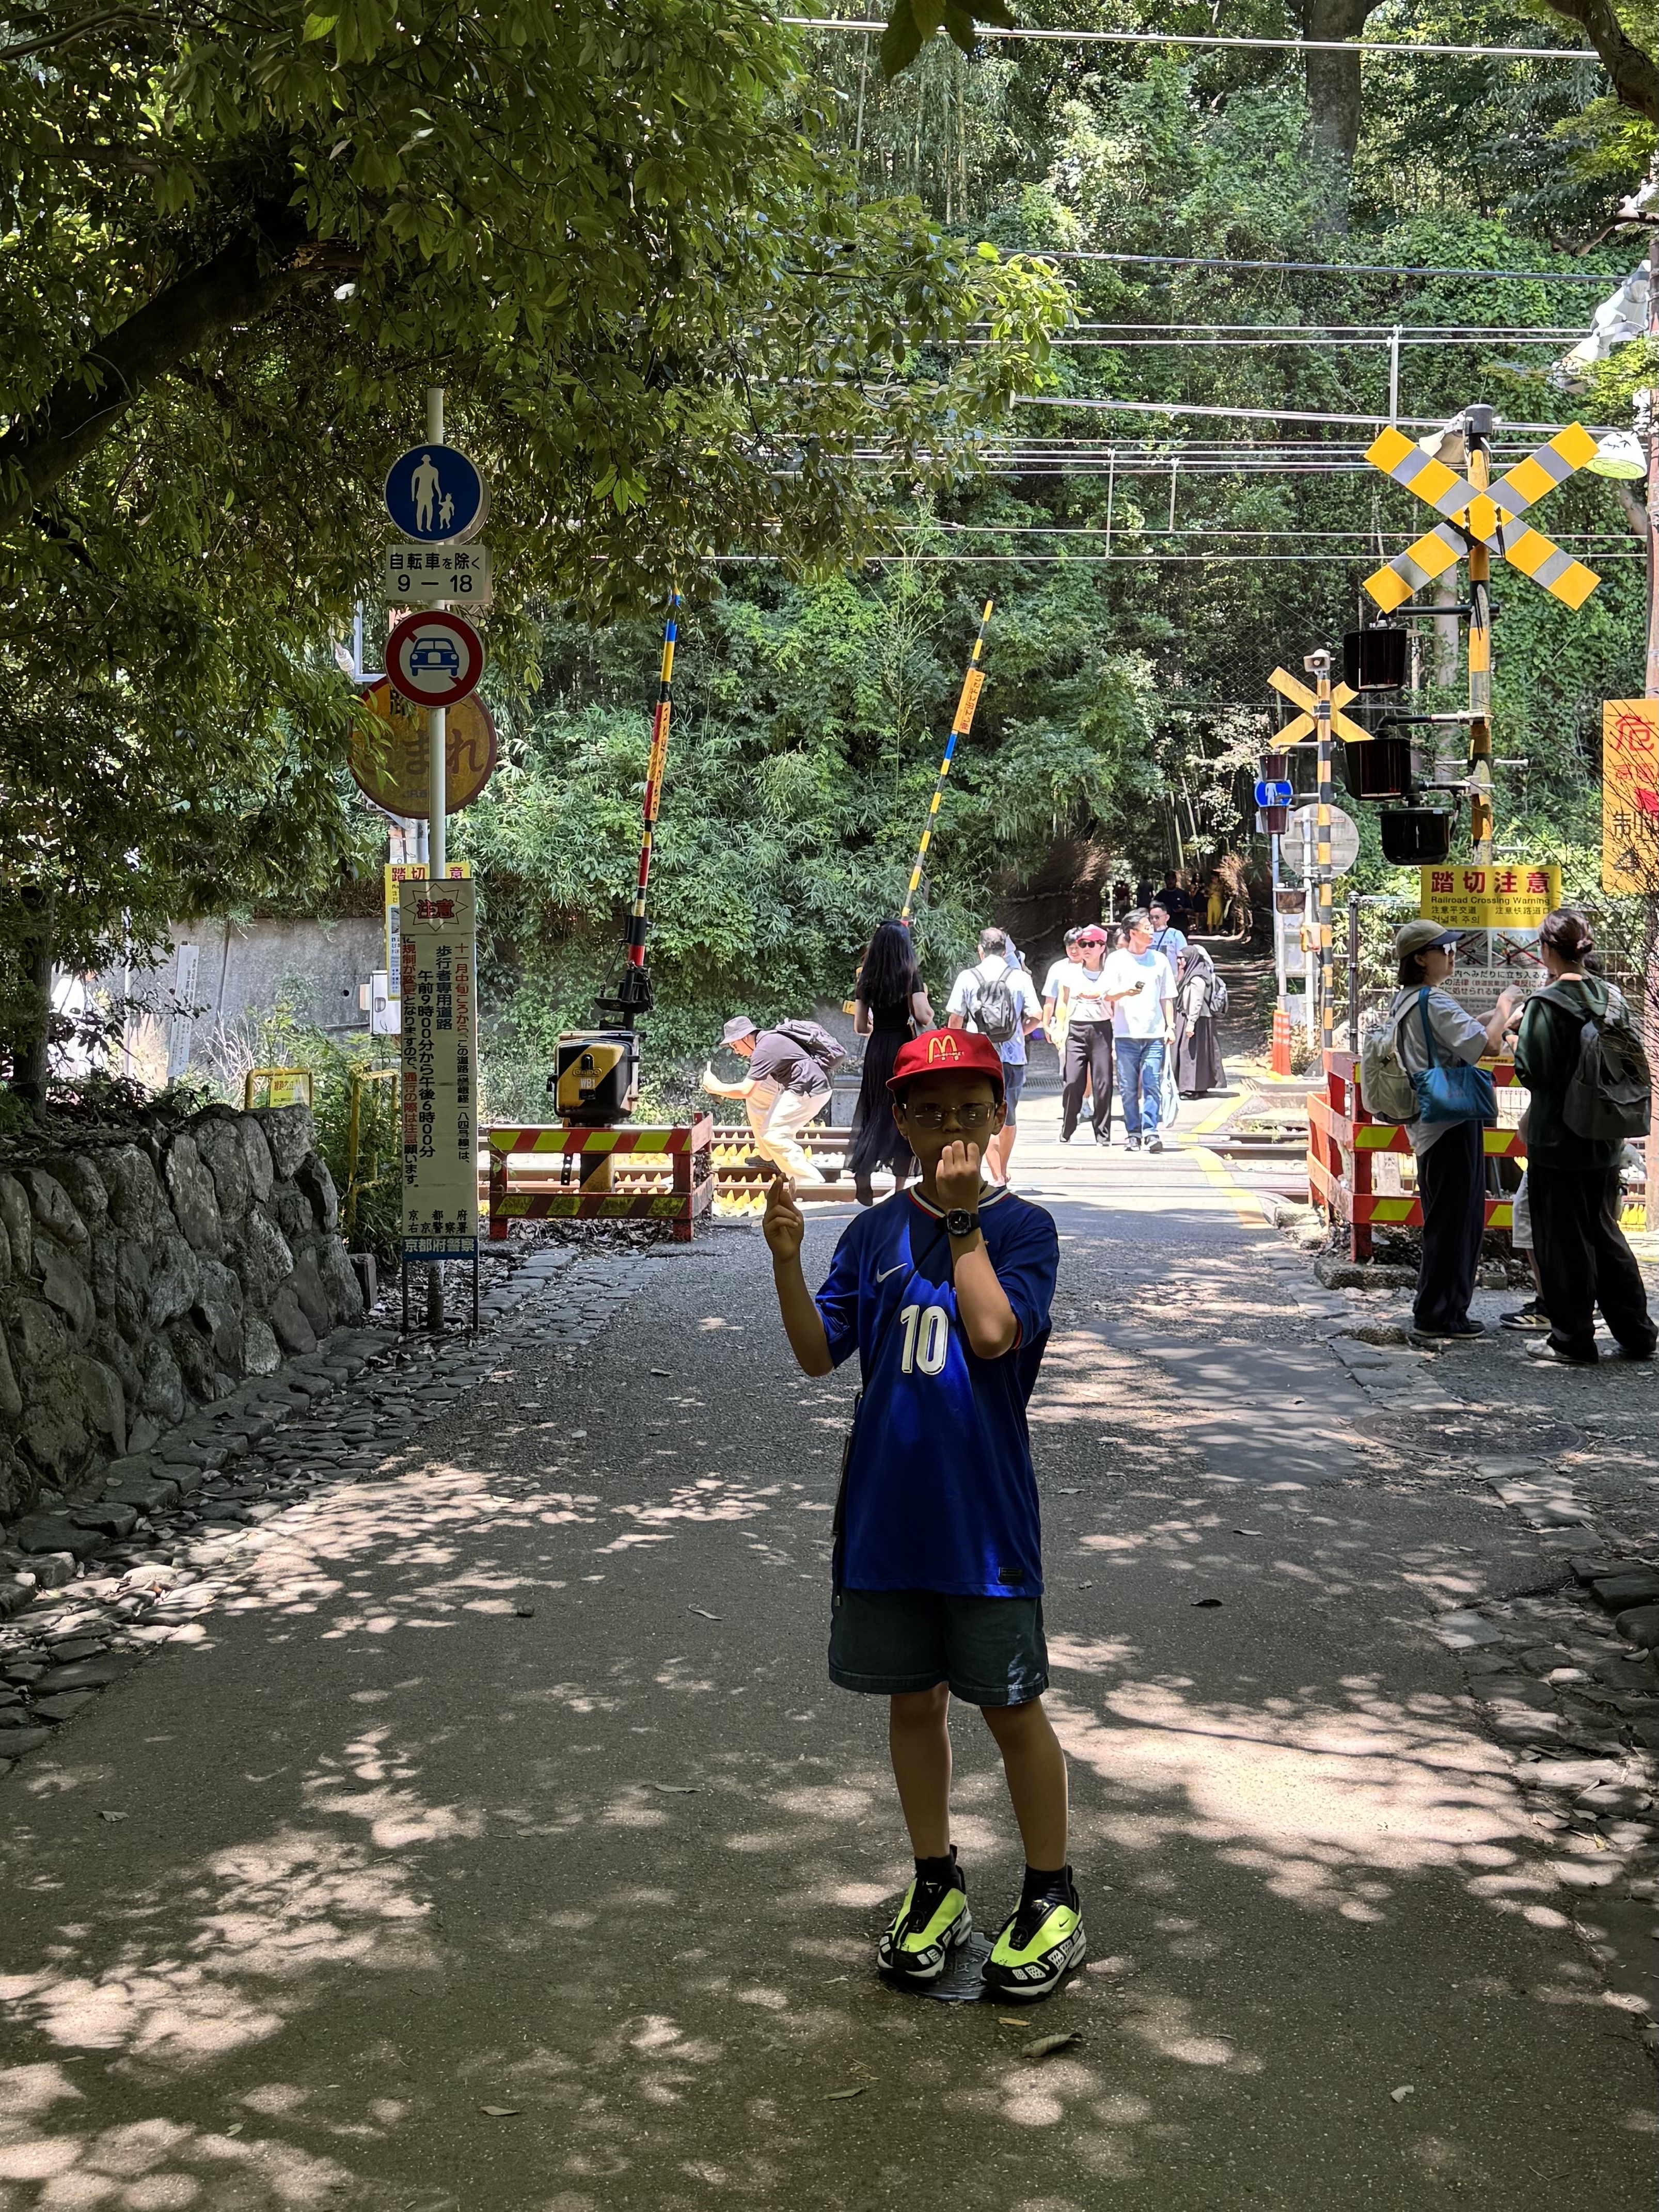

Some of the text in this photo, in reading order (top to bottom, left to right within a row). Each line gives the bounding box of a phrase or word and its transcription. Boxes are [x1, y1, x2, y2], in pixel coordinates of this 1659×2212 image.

[390, 552, 480, 570] 自転車を除く
[368, 729, 484, 774] まれ
[392, 867, 463, 882] 踏切意
[1431, 871, 1550, 893] 踏切注意
[416, 899, 455, 918] 注意
[1471, 896, 1509, 905] Crossing
[1513, 897, 1550, 906] Warning
[1462, 915, 1479, 924] 주의
[1450, 970, 1548, 979] 内へみだりに立ち入ると
[436, 945, 452, 1030] 歩行者専用道路
[408, 1222, 468, 1234] 右京警察署
[404, 1238, 474, 1252] 京都府警察
[900, 1304, 949, 1375] 10
